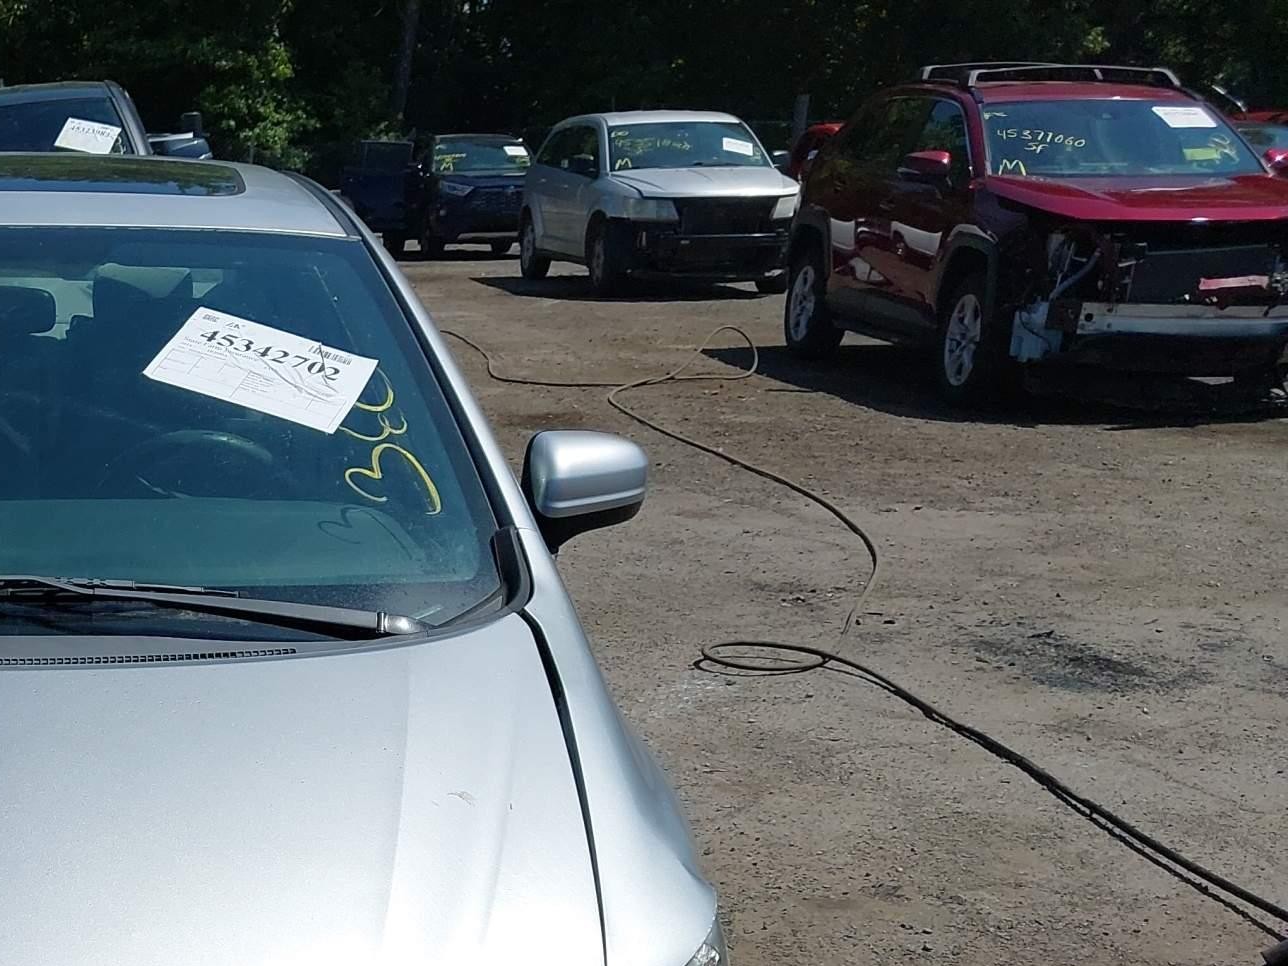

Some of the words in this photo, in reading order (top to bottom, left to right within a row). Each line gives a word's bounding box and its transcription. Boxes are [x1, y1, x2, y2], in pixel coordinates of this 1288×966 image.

[997, 128, 1086, 147] 45371060
[615, 157, 633, 171] M
[998, 159, 1027, 177] M
[199, 329, 341, 382] 45342702
